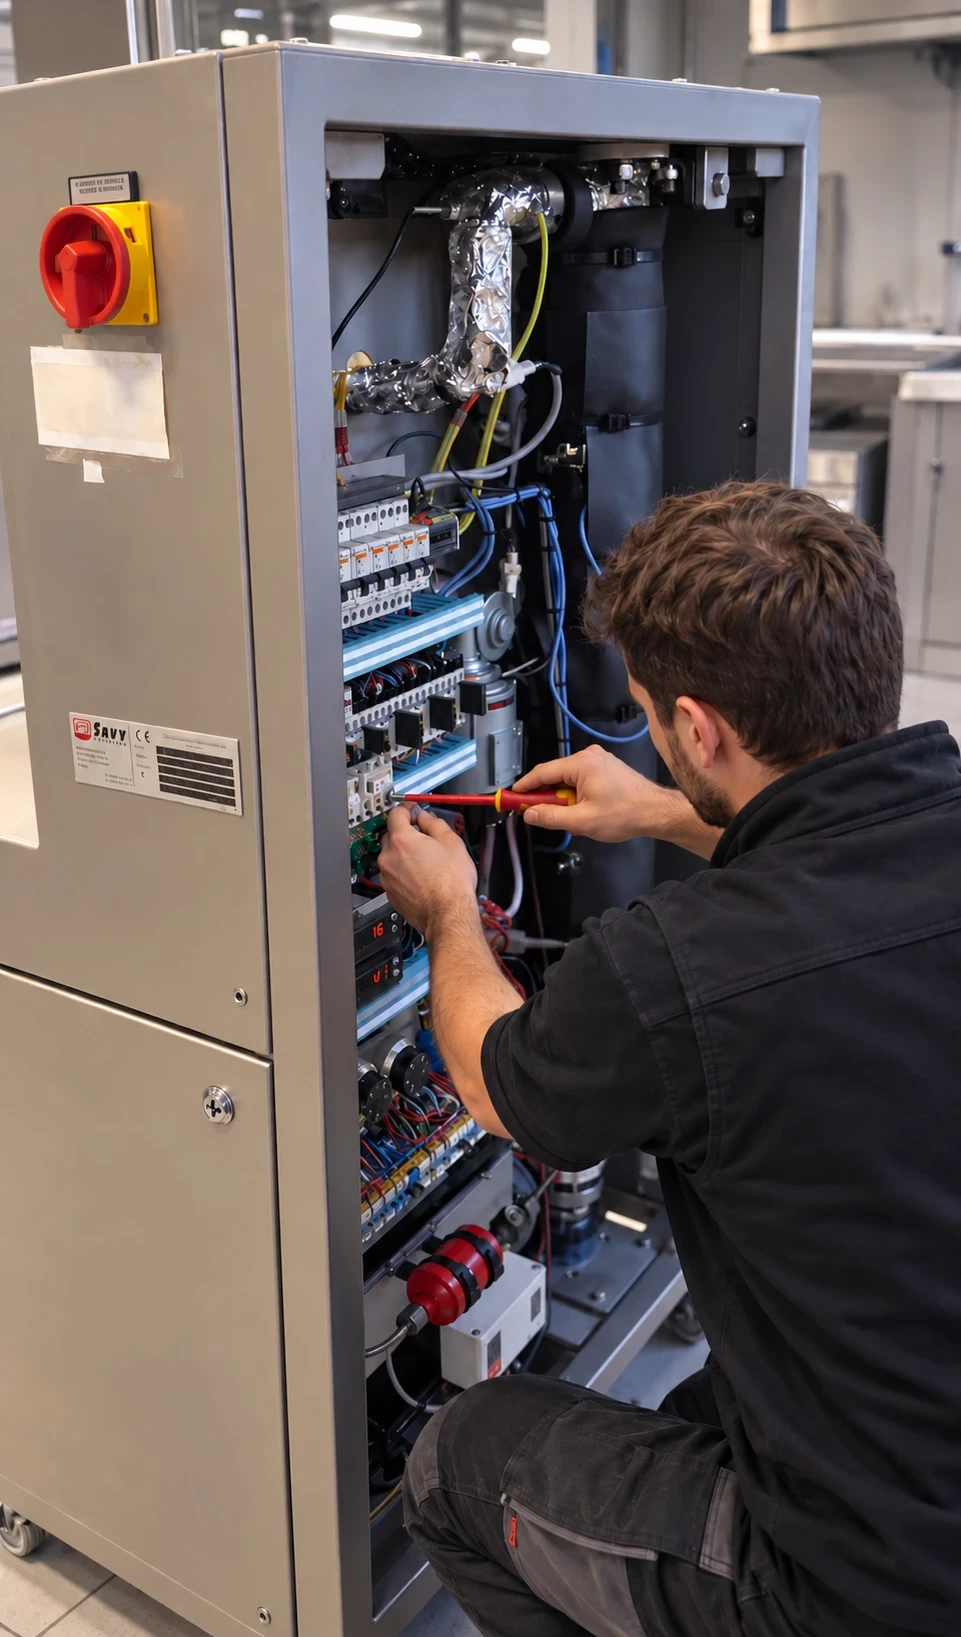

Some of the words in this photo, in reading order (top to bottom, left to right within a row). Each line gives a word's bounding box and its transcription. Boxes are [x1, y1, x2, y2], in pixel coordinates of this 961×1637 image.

[94, 722, 126, 741] SAVY
[136, 730, 150, 743] CE
[373, 922, 384, 938] 16
